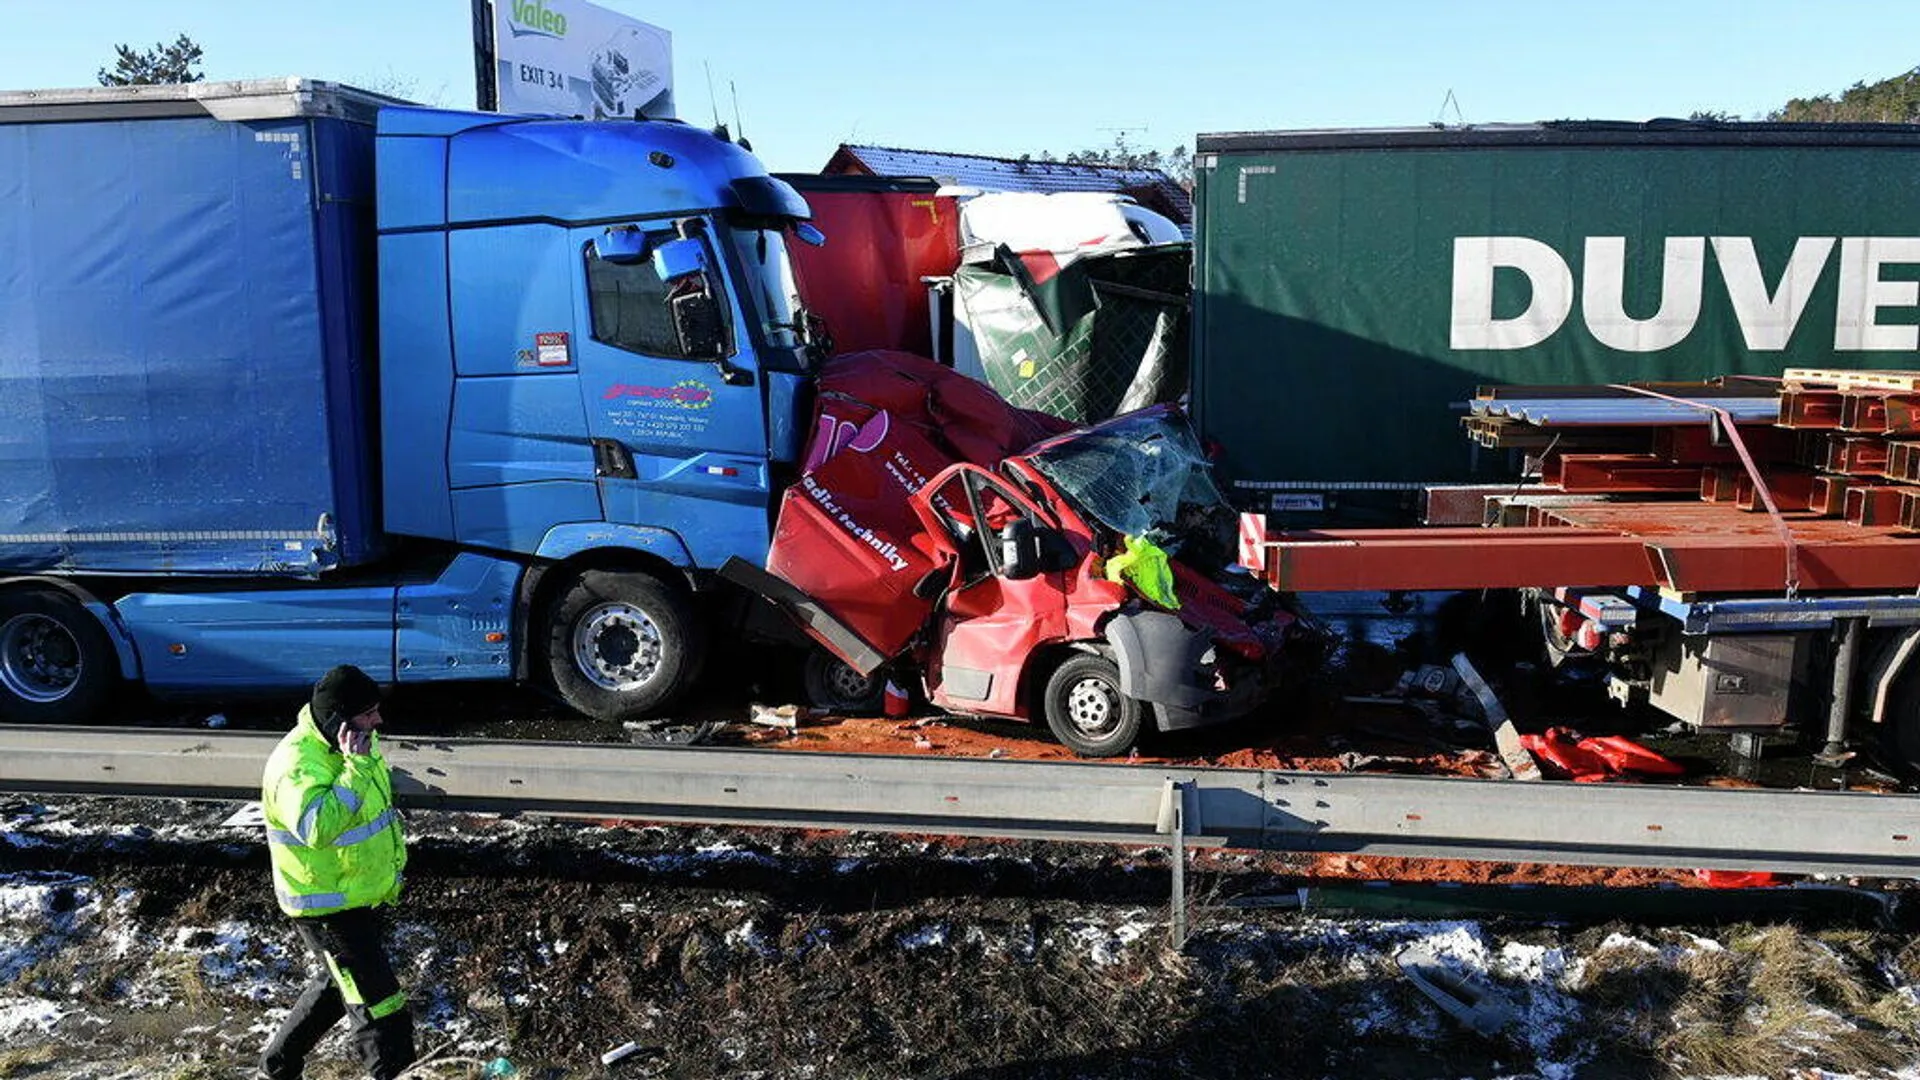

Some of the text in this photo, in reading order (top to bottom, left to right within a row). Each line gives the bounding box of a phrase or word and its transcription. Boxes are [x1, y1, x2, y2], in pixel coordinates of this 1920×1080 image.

[511, 0, 567, 36] Valeo
[520, 64, 564, 90] EXIT 34
[1450, 235, 1920, 352] DUVE
[838, 512, 909, 572] techniky
